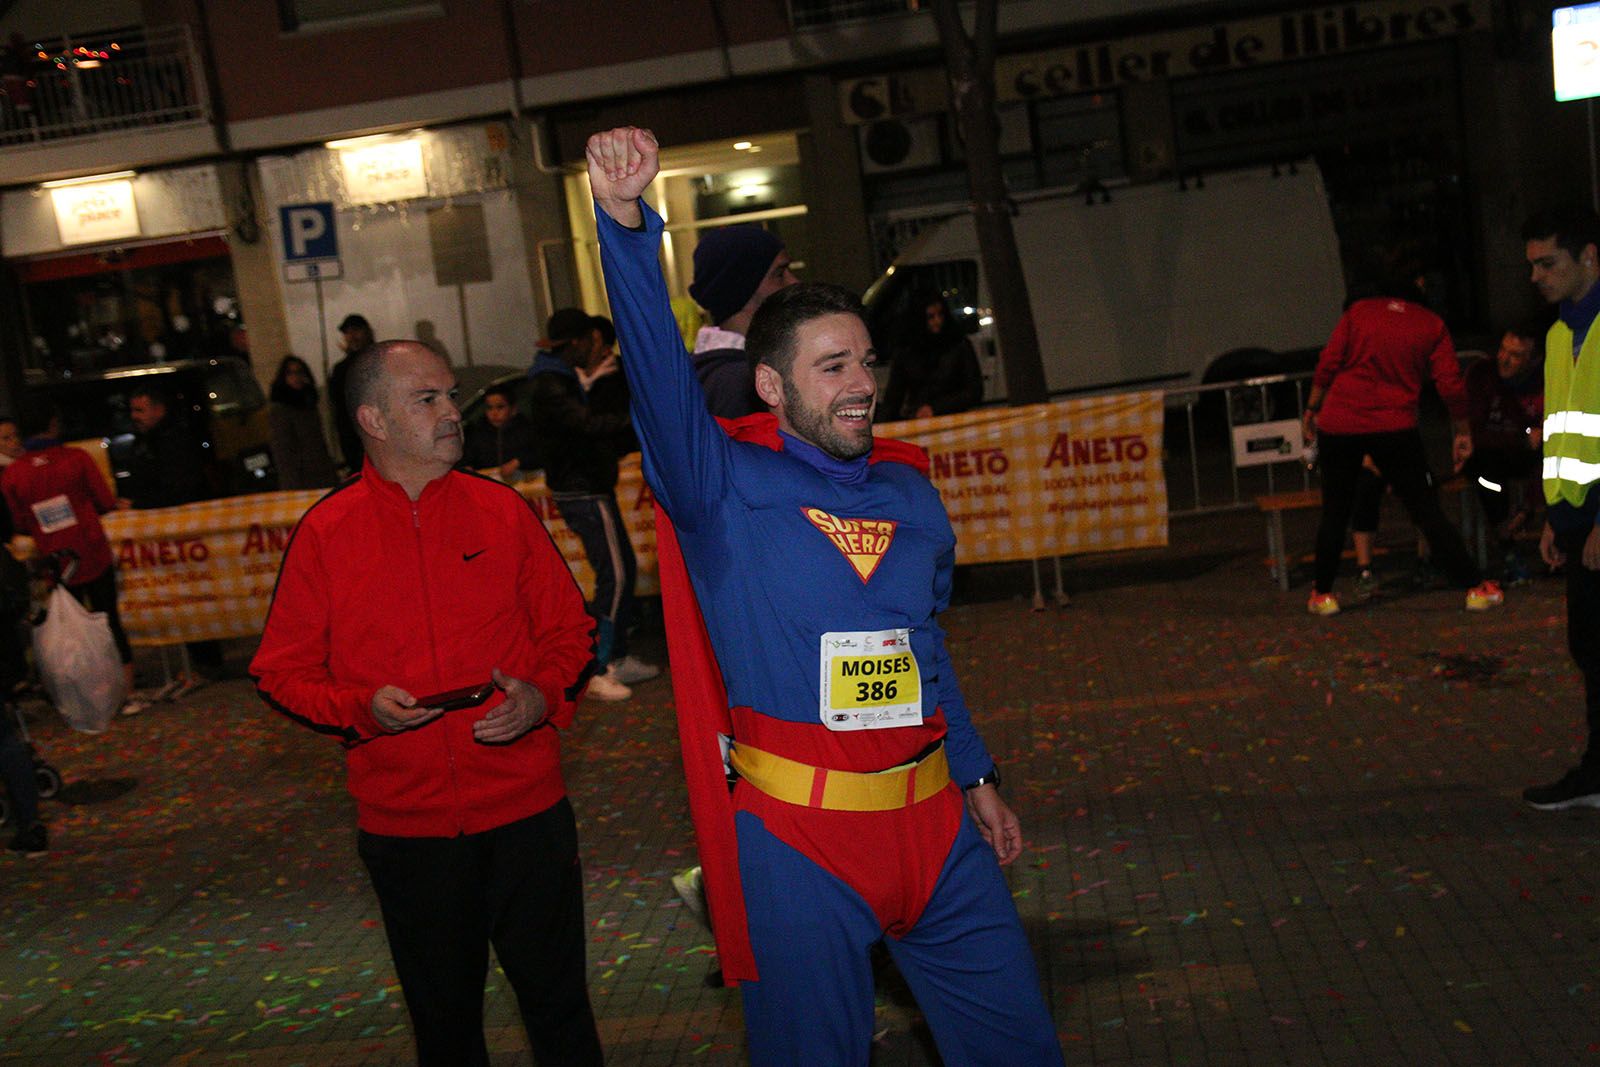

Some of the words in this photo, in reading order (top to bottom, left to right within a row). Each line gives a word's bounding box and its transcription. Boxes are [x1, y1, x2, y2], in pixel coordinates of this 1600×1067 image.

[1014, 44, 1171, 97] celler
[1187, 25, 1265, 70] de
[1281, 2, 1476, 56] llibres
[289, 209, 326, 256] P
[1044, 433, 1148, 468] ANETO
[1081, 471, 1146, 488] NATURAL
[118, 536, 208, 570] ANETO
[828, 533, 890, 554] HERO
[842, 657, 911, 677] MOISES
[856, 680, 898, 702] 386
